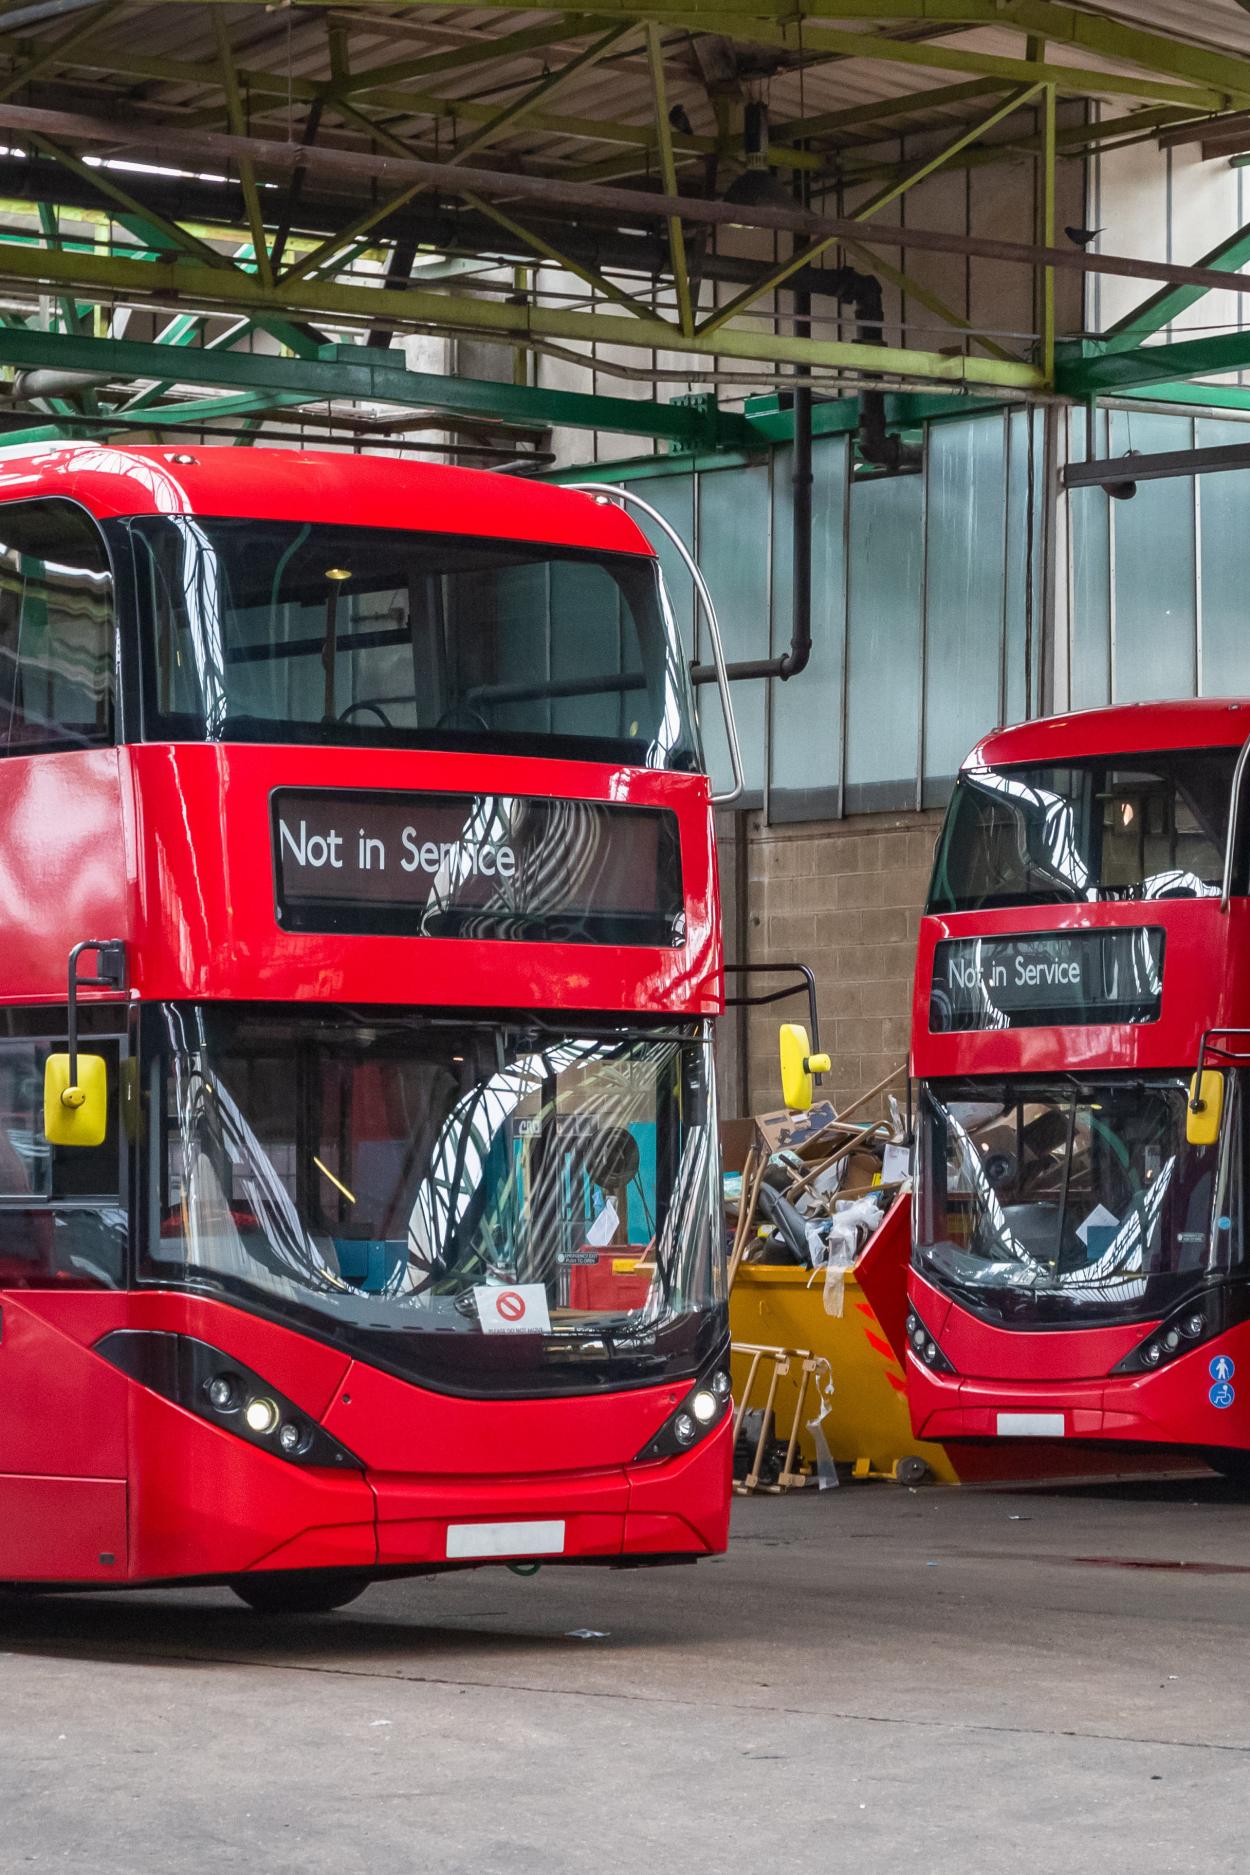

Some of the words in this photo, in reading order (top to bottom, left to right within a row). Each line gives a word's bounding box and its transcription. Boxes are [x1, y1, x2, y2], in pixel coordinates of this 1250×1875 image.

[279, 819, 343, 868] Not
[358, 828, 385, 870] in
[949, 957, 984, 989] Not
[990, 960, 1007, 987] in
[1014, 955, 1080, 986] Service
